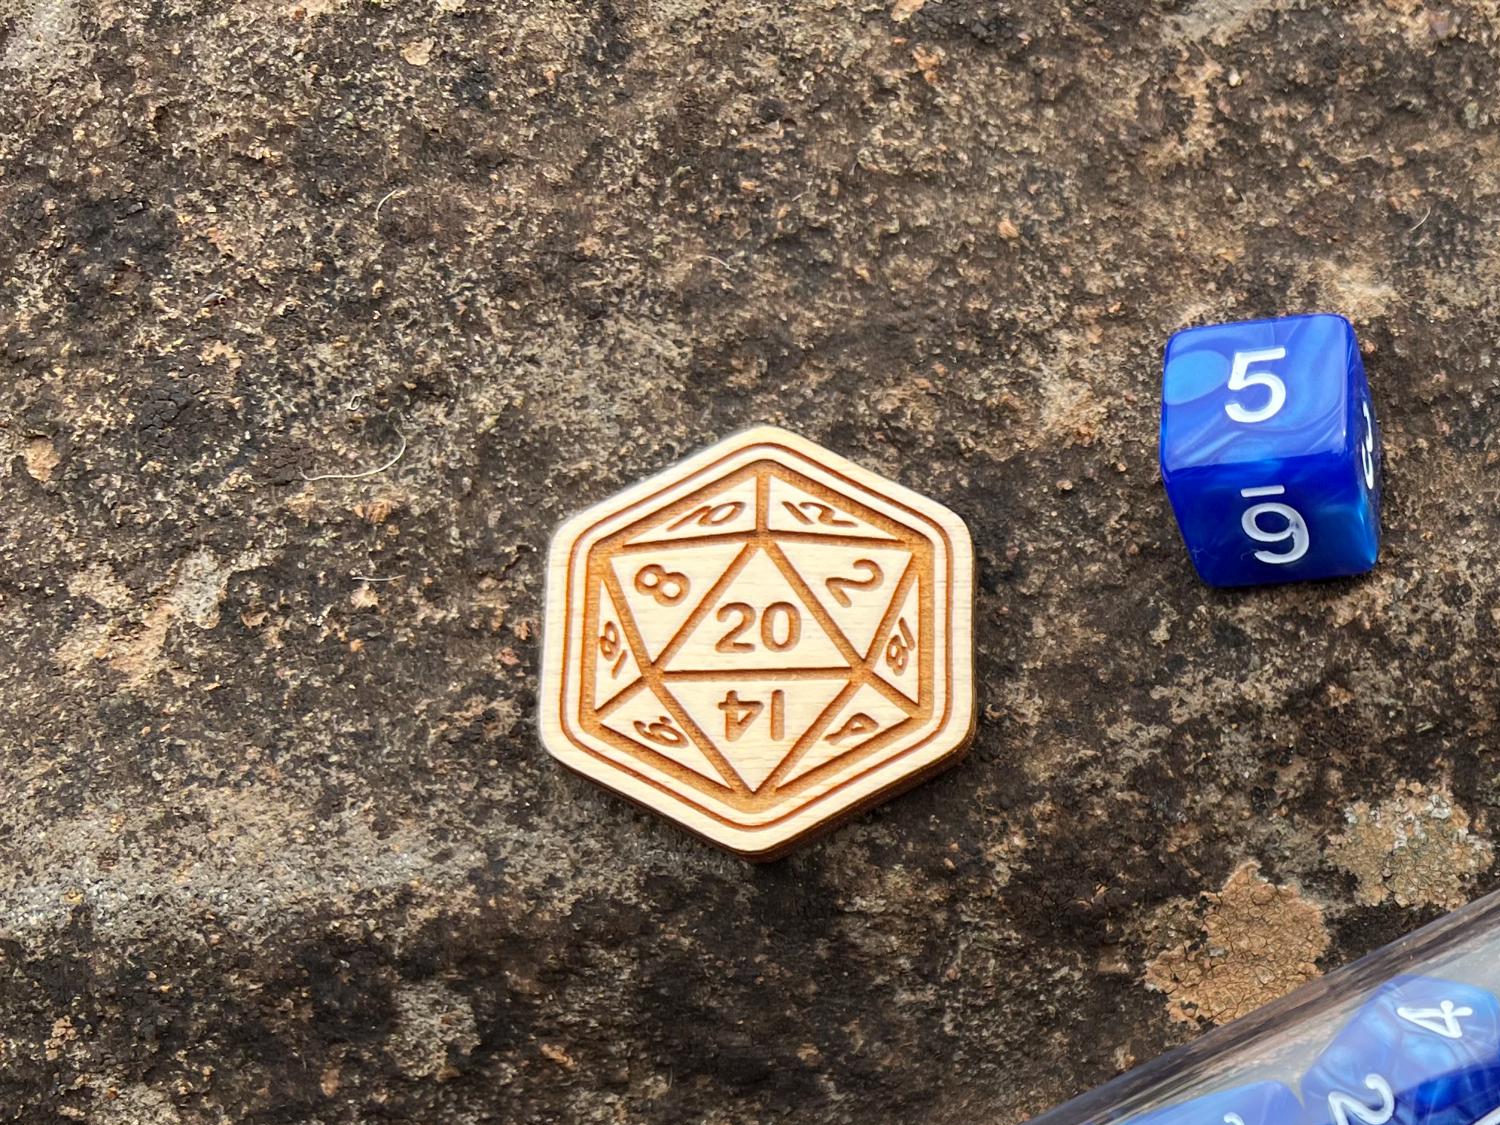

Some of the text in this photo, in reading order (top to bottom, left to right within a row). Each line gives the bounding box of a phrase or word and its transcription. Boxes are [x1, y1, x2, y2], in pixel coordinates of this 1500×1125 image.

[1225, 347, 1286, 423] 5
[667, 501, 744, 532] 10
[781, 500, 858, 528] 12
[633, 563, 690, 606] 8
[825, 559, 884, 608] 2
[715, 601, 800, 653] 20
[718, 689, 784, 741] 14
[825, 712, 880, 745] 4
[1397, 999, 1473, 1039] 4
